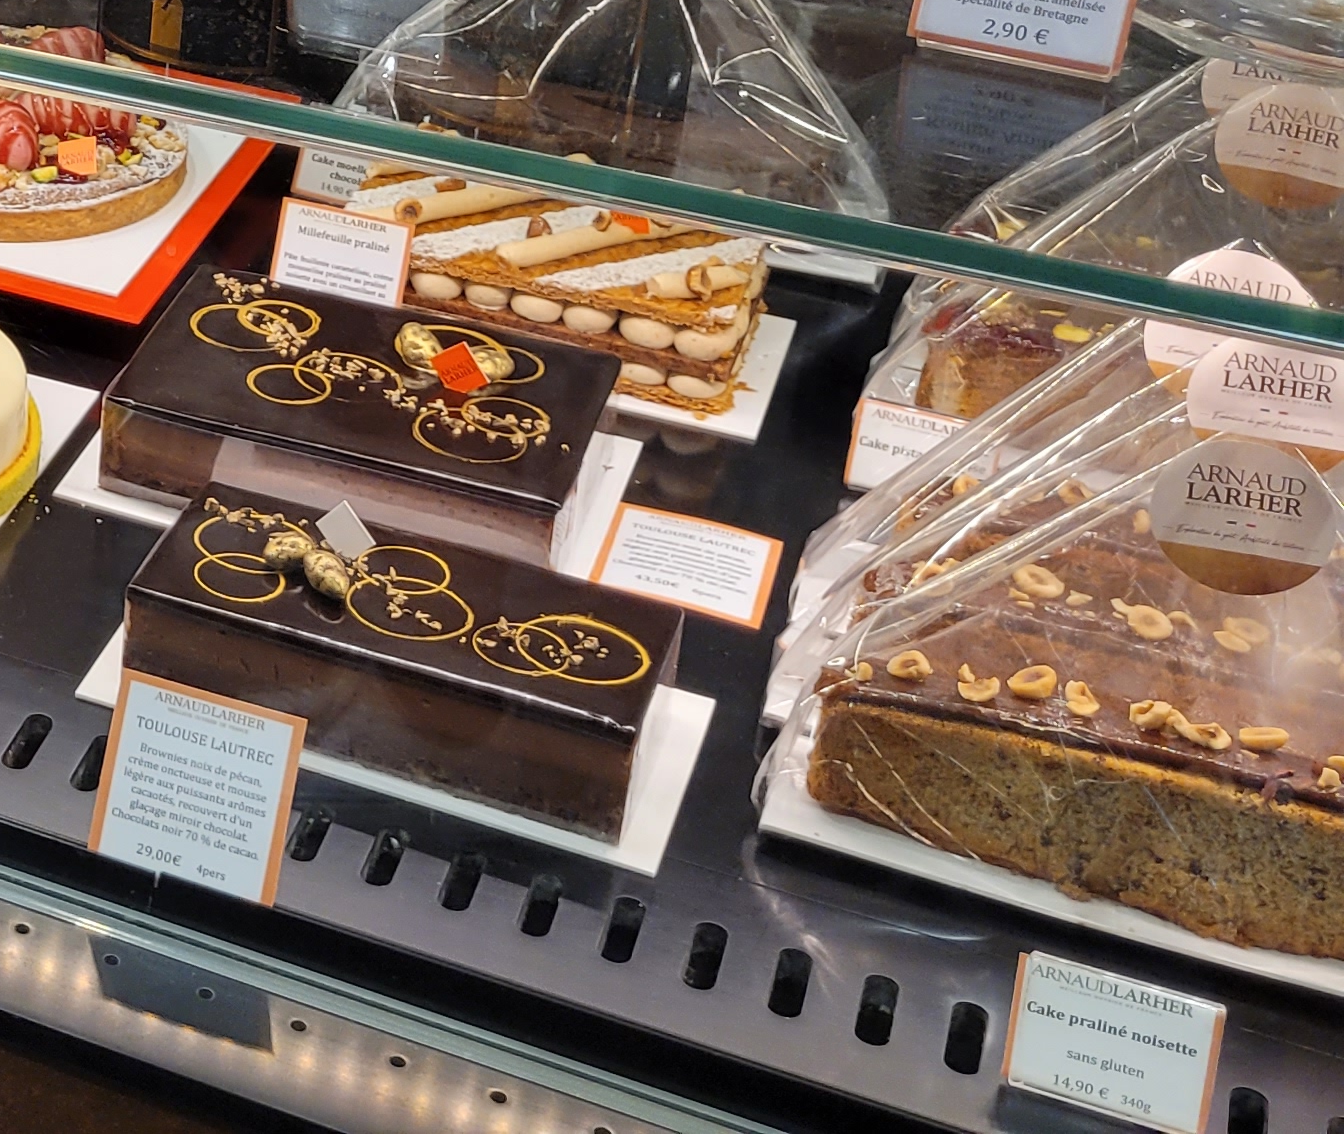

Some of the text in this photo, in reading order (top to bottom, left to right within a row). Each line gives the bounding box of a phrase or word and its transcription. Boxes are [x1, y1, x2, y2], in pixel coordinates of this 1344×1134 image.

[1016, 2, 1030, 14] de
[1034, 6, 1088, 25] Bretagne
[982, 19, 1050, 45] 2,90 €
[1247, 117, 1340, 149] LARHER
[1250, 102, 1344, 132] ARNAUD
[298, 225, 390, 254] Millefeuille praliné
[1224, 351, 1337, 384] ARNAUD
[1223, 369, 1333, 403] LARHER
[1187, 462, 1306, 496] ARNAUD
[1185, 482, 1302, 517] LARHER
[155, 691, 265, 731] ARNAUDLARHER
[136, 715, 275, 766] TOULOUSE LAUTREC
[140, 742, 188, 765] Brownies
[190, 758, 212, 773] noix
[215, 765, 228, 777] de
[136, 842, 226, 882] 29,00€ 4pers
[1031, 963, 1193, 1018] ARNAUDLARHER
[1027, 1000, 1198, 1058] Cake praliné noisette
[1066, 1049, 1145, 1080] sans gluten
[1053, 1073, 1152, 1115] 14,90 € 340g
